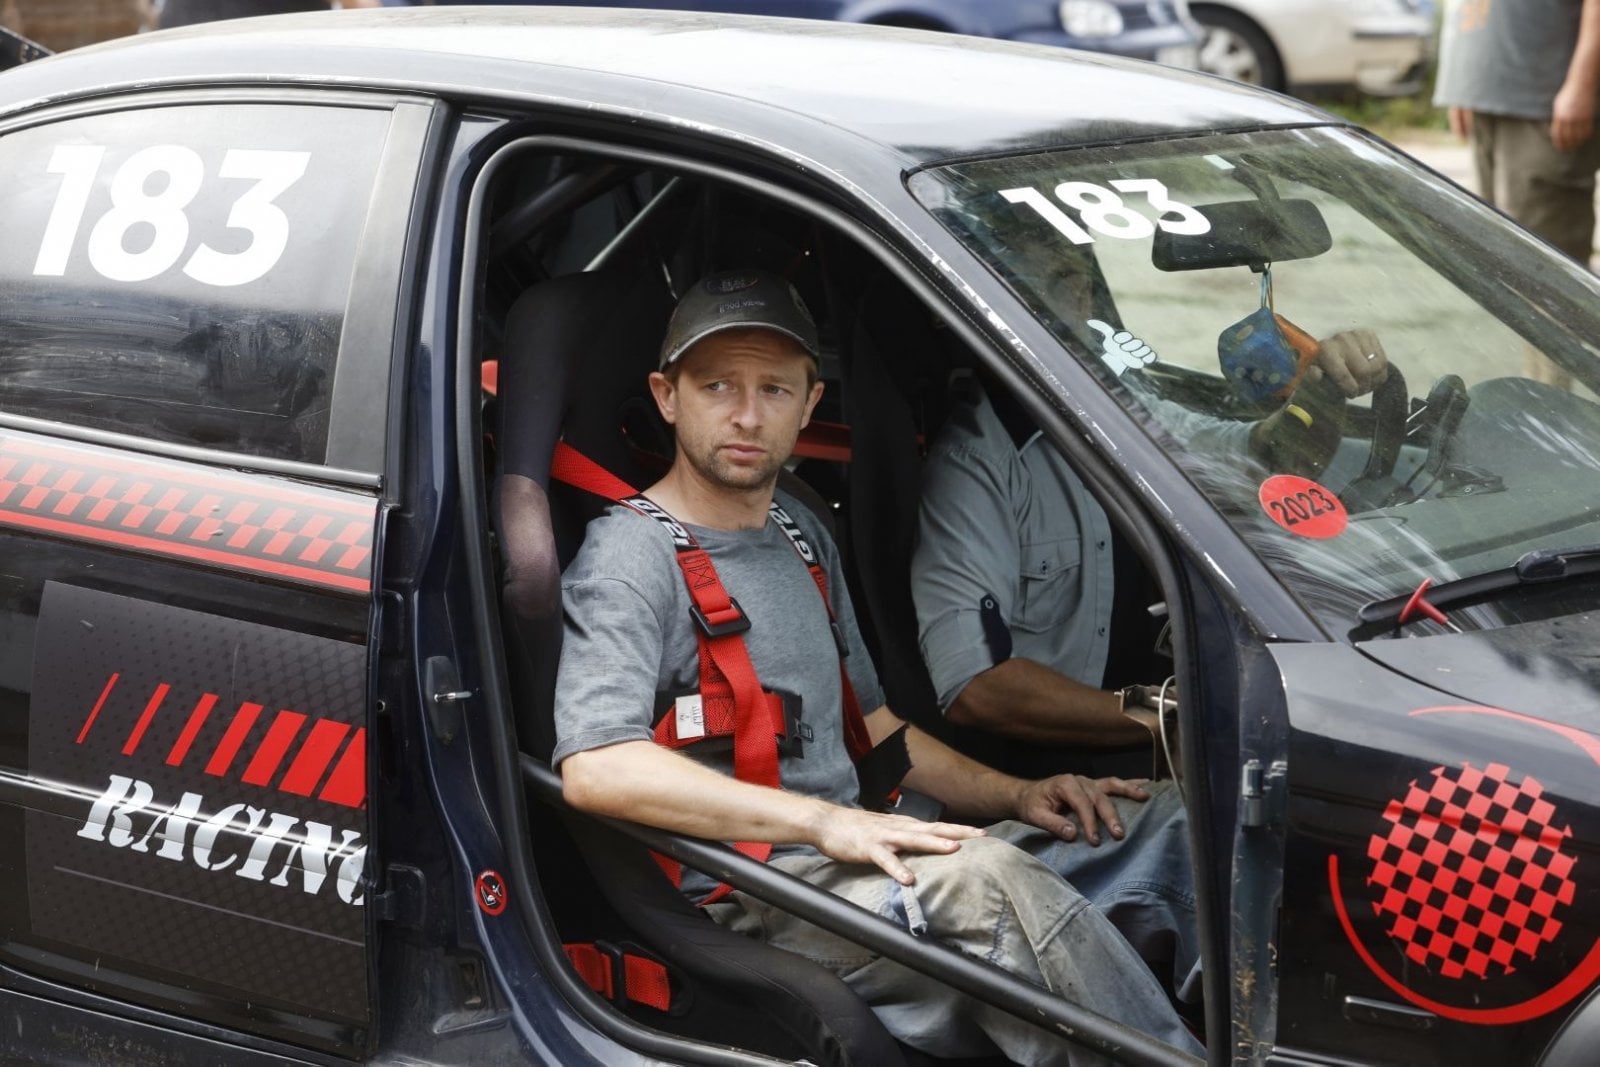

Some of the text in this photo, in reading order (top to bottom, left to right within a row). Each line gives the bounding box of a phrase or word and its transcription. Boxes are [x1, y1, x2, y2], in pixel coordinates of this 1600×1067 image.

[33, 144, 311, 286] 183
[998, 178, 1211, 245] 183
[1270, 488, 1336, 526] 2023
